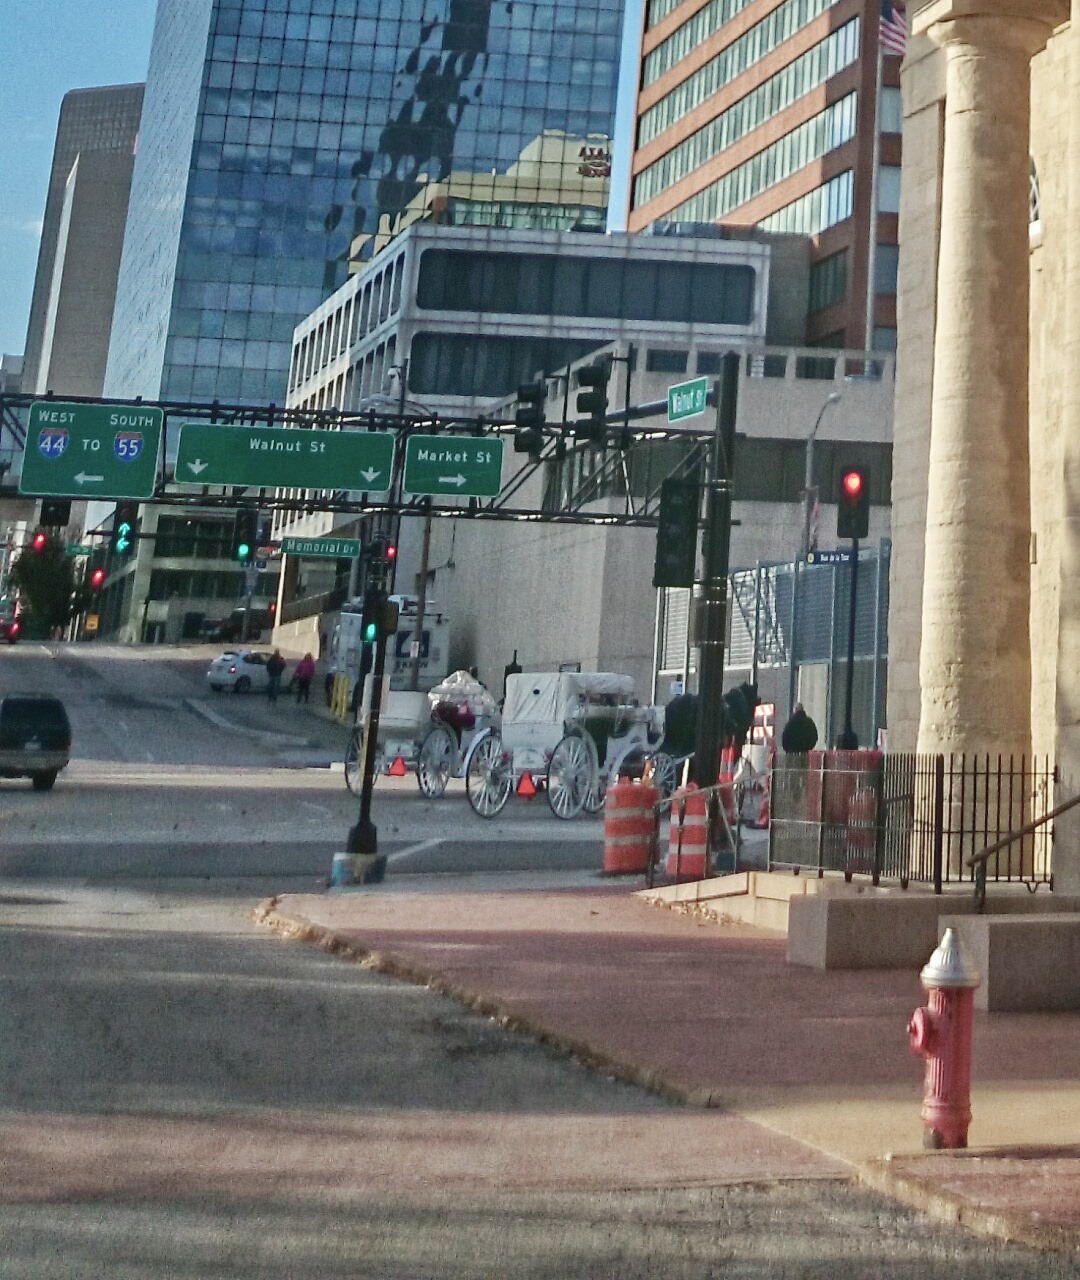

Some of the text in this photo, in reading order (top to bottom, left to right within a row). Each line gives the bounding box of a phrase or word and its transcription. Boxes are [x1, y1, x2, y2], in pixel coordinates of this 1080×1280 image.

[673, 389, 693, 414] Walnut
[39, 410, 154, 427] WEST SOUTH
[40, 436, 138, 456] 44 TO 55
[249, 438, 326, 453] Walnut St
[417, 449, 492, 464] Market St
[287, 540, 340, 552] Memorial
